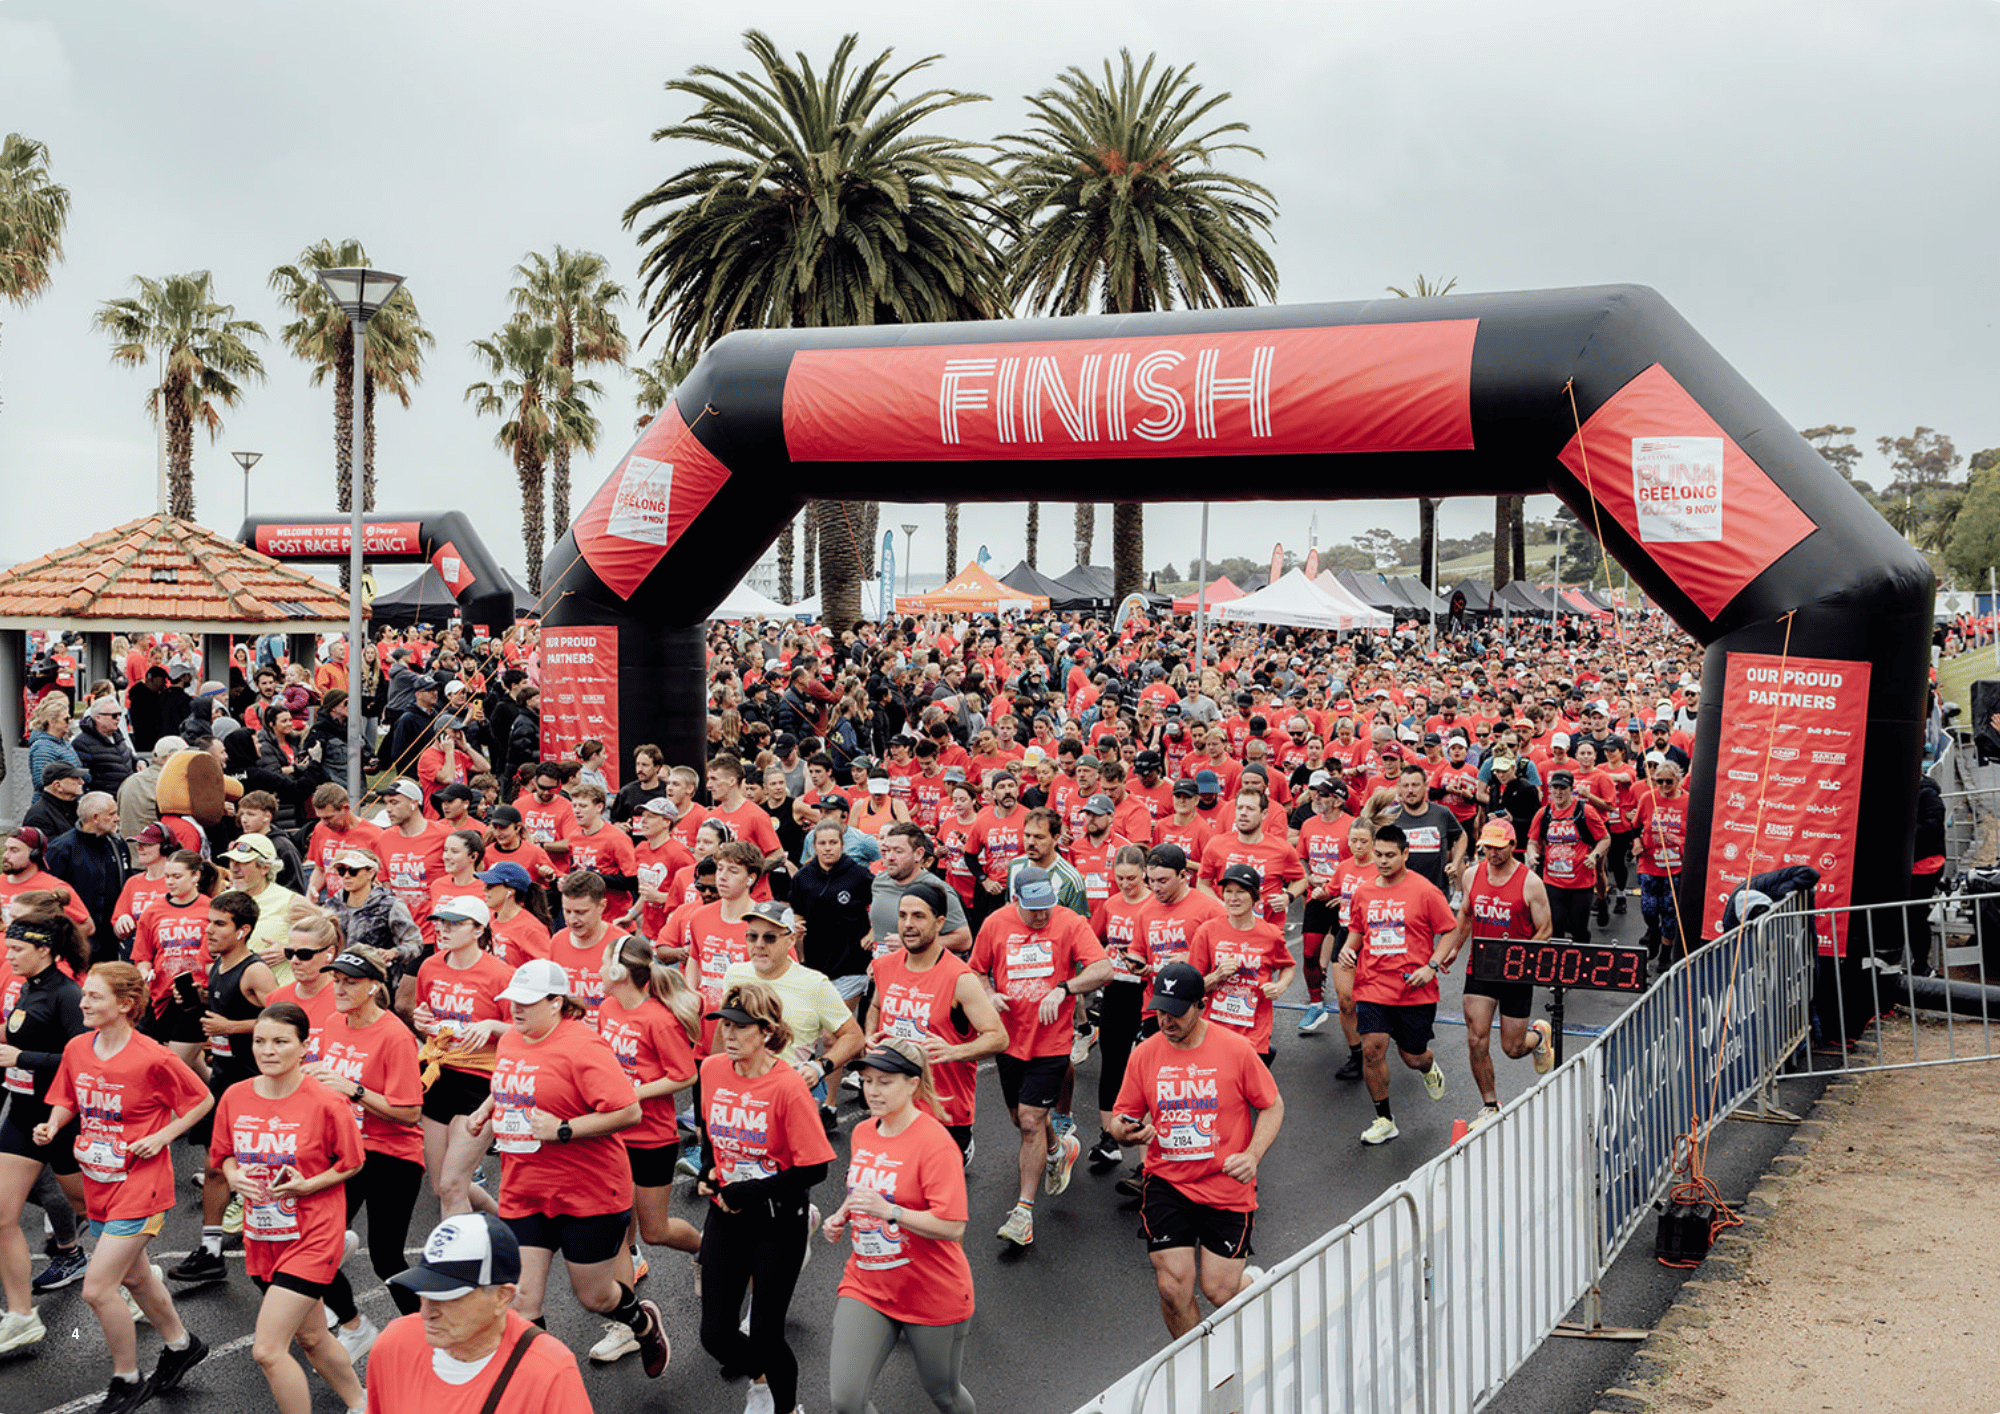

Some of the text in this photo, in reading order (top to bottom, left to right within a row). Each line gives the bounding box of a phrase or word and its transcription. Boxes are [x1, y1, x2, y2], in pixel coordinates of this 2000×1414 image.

[940, 346, 1275, 444] FINISH
[1639, 485, 1717, 501] GEELONG
[617, 493, 666, 513] GEELONG
[1685, 504, 1717, 515] 9 NOV
[648, 516, 665, 525] NOV
[277, 528, 312, 537] WELCOME
[314, 528, 324, 536] TO
[325, 527, 340, 536] THE
[268, 538, 407, 553] POST RACE PECINCT
[560, 636, 597, 648] PROUD
[547, 653, 594, 664] PARTNERS
[1746, 668, 1843, 688] OUR PROUD
[1748, 690, 1837, 710] PARTNERS
[1367, 908, 1405, 923] RUN4
[1474, 903, 1511, 921] RUN4
[159, 926, 201, 943] RUN4
[1149, 926, 1186, 949] RUN4
[1503, 945, 1640, 988] 8:00:23
[430, 991, 474, 1015] RUN4
[882, 995, 931, 1019] RUN4
[492, 1071, 536, 1096] RUN4
[1157, 1078, 1218, 1104] RUN4
[1158, 1098, 1218, 1111] GEELONG
[710, 1103, 768, 1132] RUN4
[1161, 1110, 1192, 1122] 2025
[233, 1131, 297, 1155] RUN4
